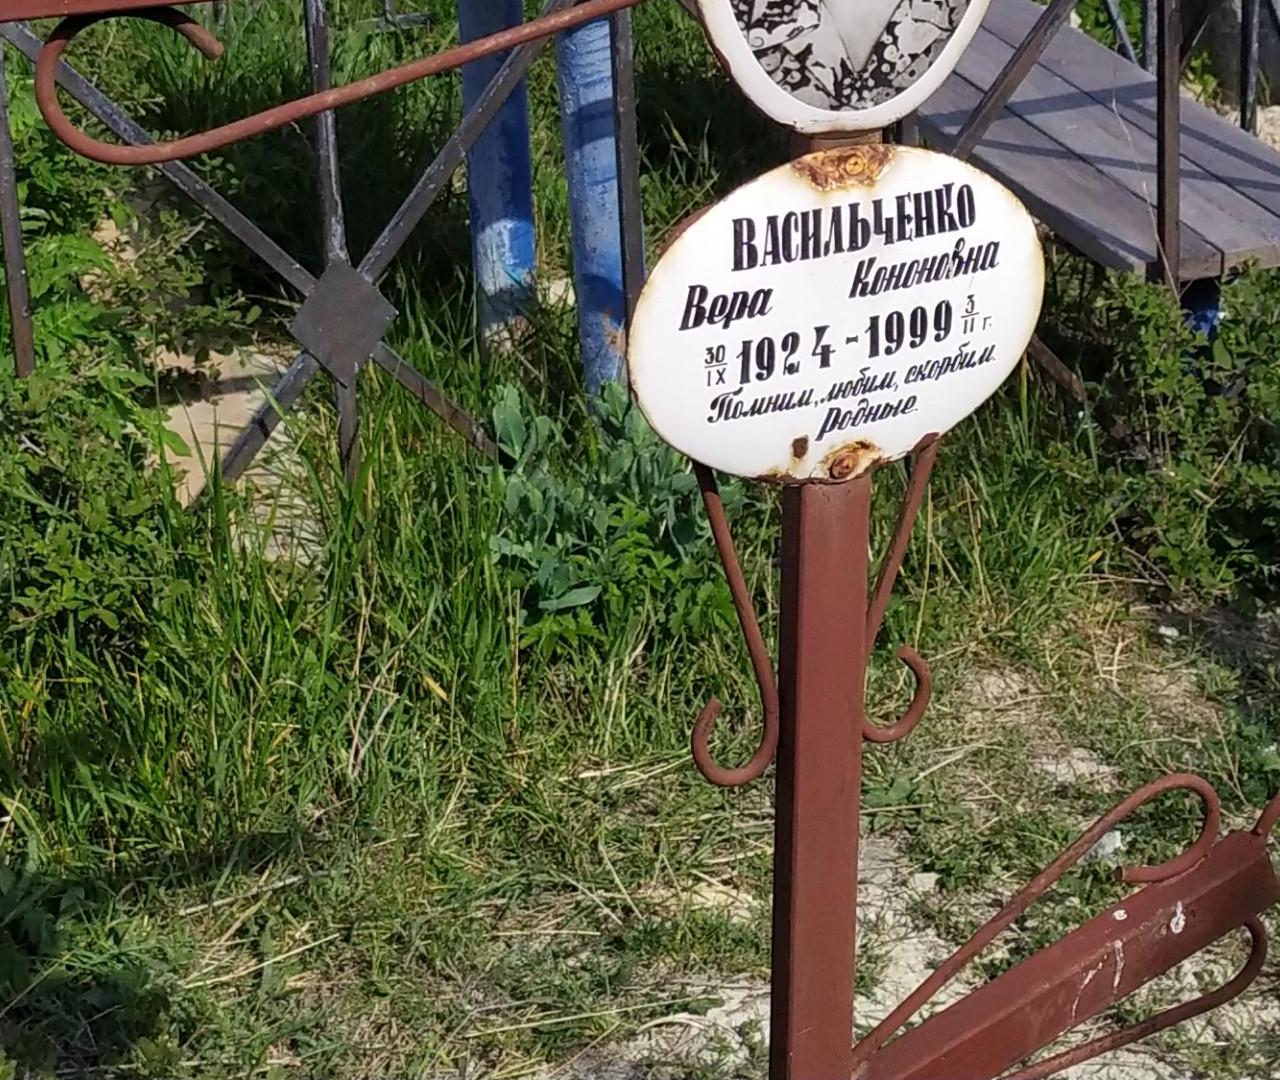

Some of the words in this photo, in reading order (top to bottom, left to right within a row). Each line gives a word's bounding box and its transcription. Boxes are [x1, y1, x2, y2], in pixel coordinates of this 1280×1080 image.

[731, 182, 976, 272] ВАСИЛЬЧЕНКО
[849, 237, 1000, 299] Кононовна
[678, 284, 774, 332] Вера
[819, 367, 900, 403] любим,
